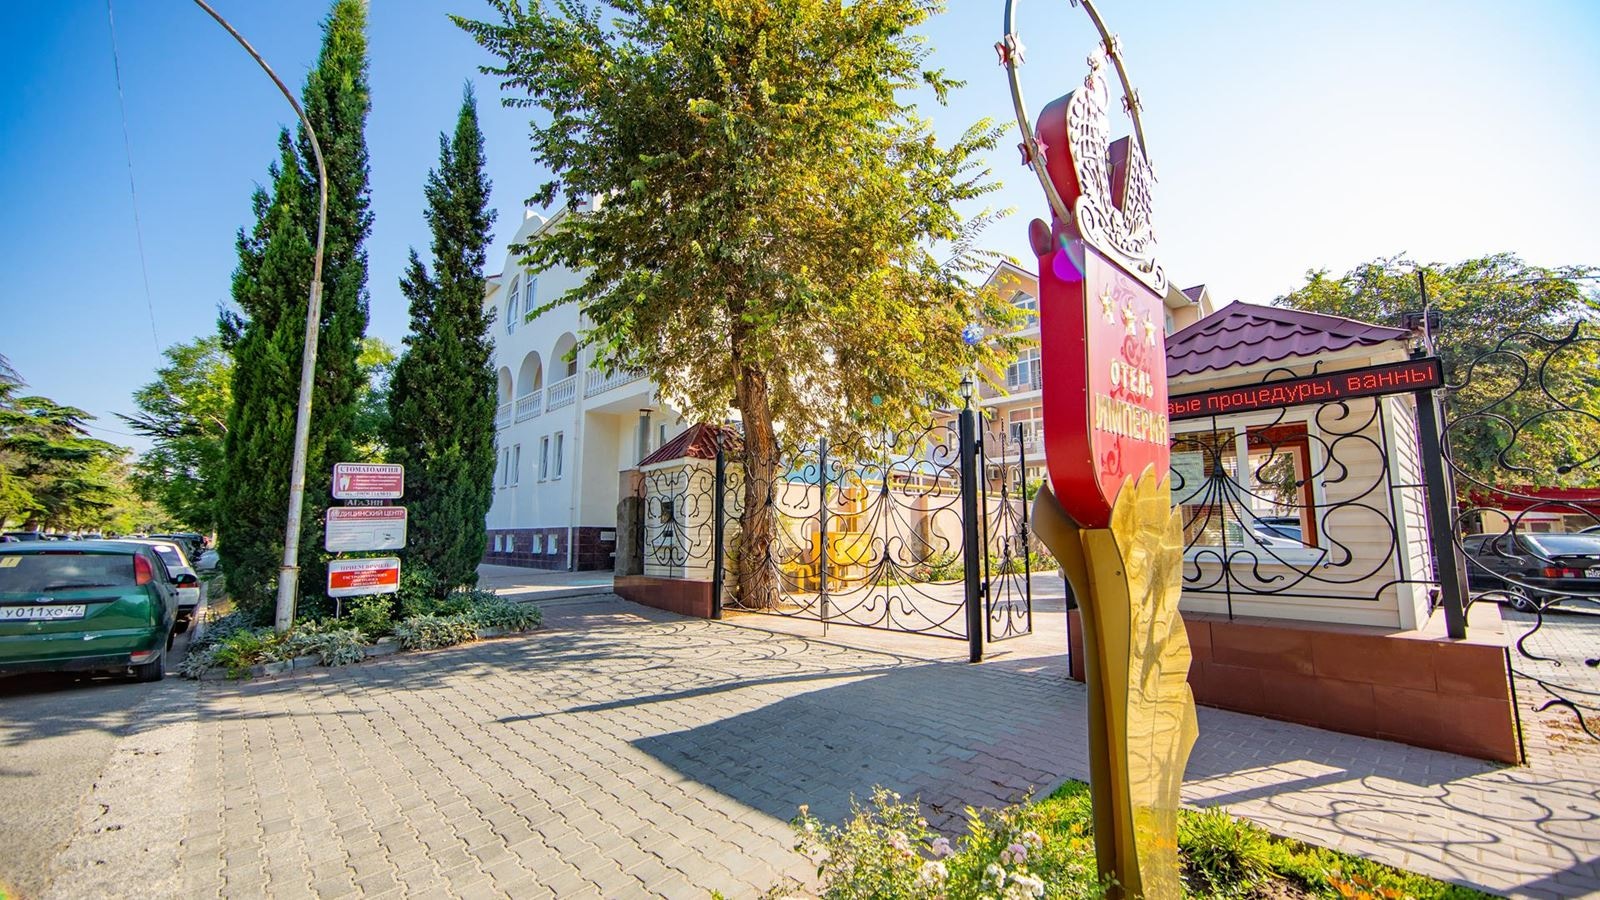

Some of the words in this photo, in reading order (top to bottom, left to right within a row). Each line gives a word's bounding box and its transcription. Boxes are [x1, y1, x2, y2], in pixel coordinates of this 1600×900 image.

[1110, 359, 1154, 399] ОТЕЛЬ
[1208, 380, 1339, 411] процедуры,
[1347, 366, 1433, 391] ванны
[1095, 393, 1168, 446] ИМПЕРИЯ
